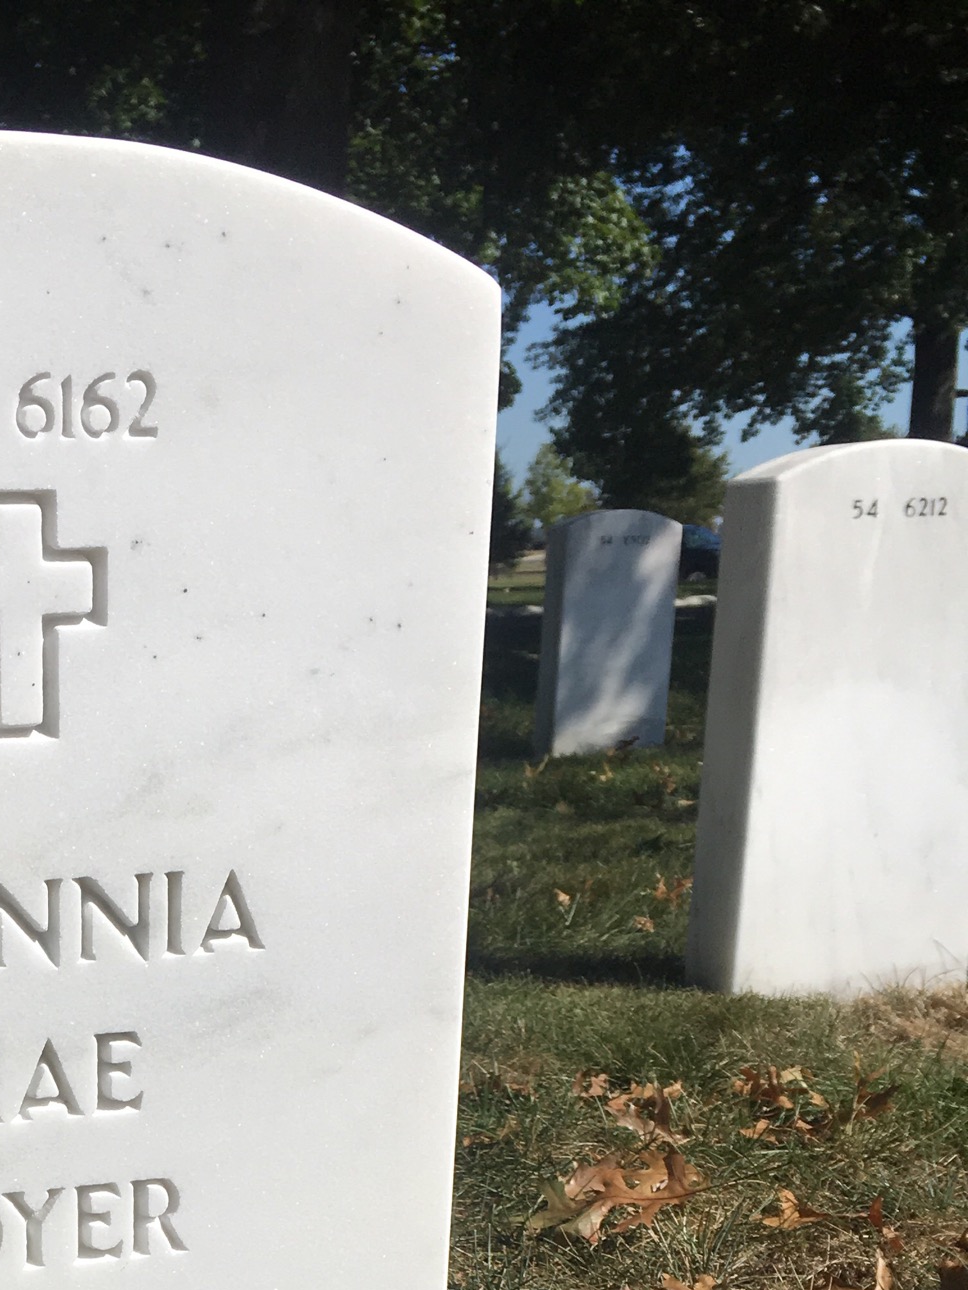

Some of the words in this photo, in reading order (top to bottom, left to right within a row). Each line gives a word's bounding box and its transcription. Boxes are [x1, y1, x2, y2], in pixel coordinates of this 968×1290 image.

[16, 369, 159, 439] 6162
[852, 499, 878, 519] 54
[904, 497, 948, 518] 6212
